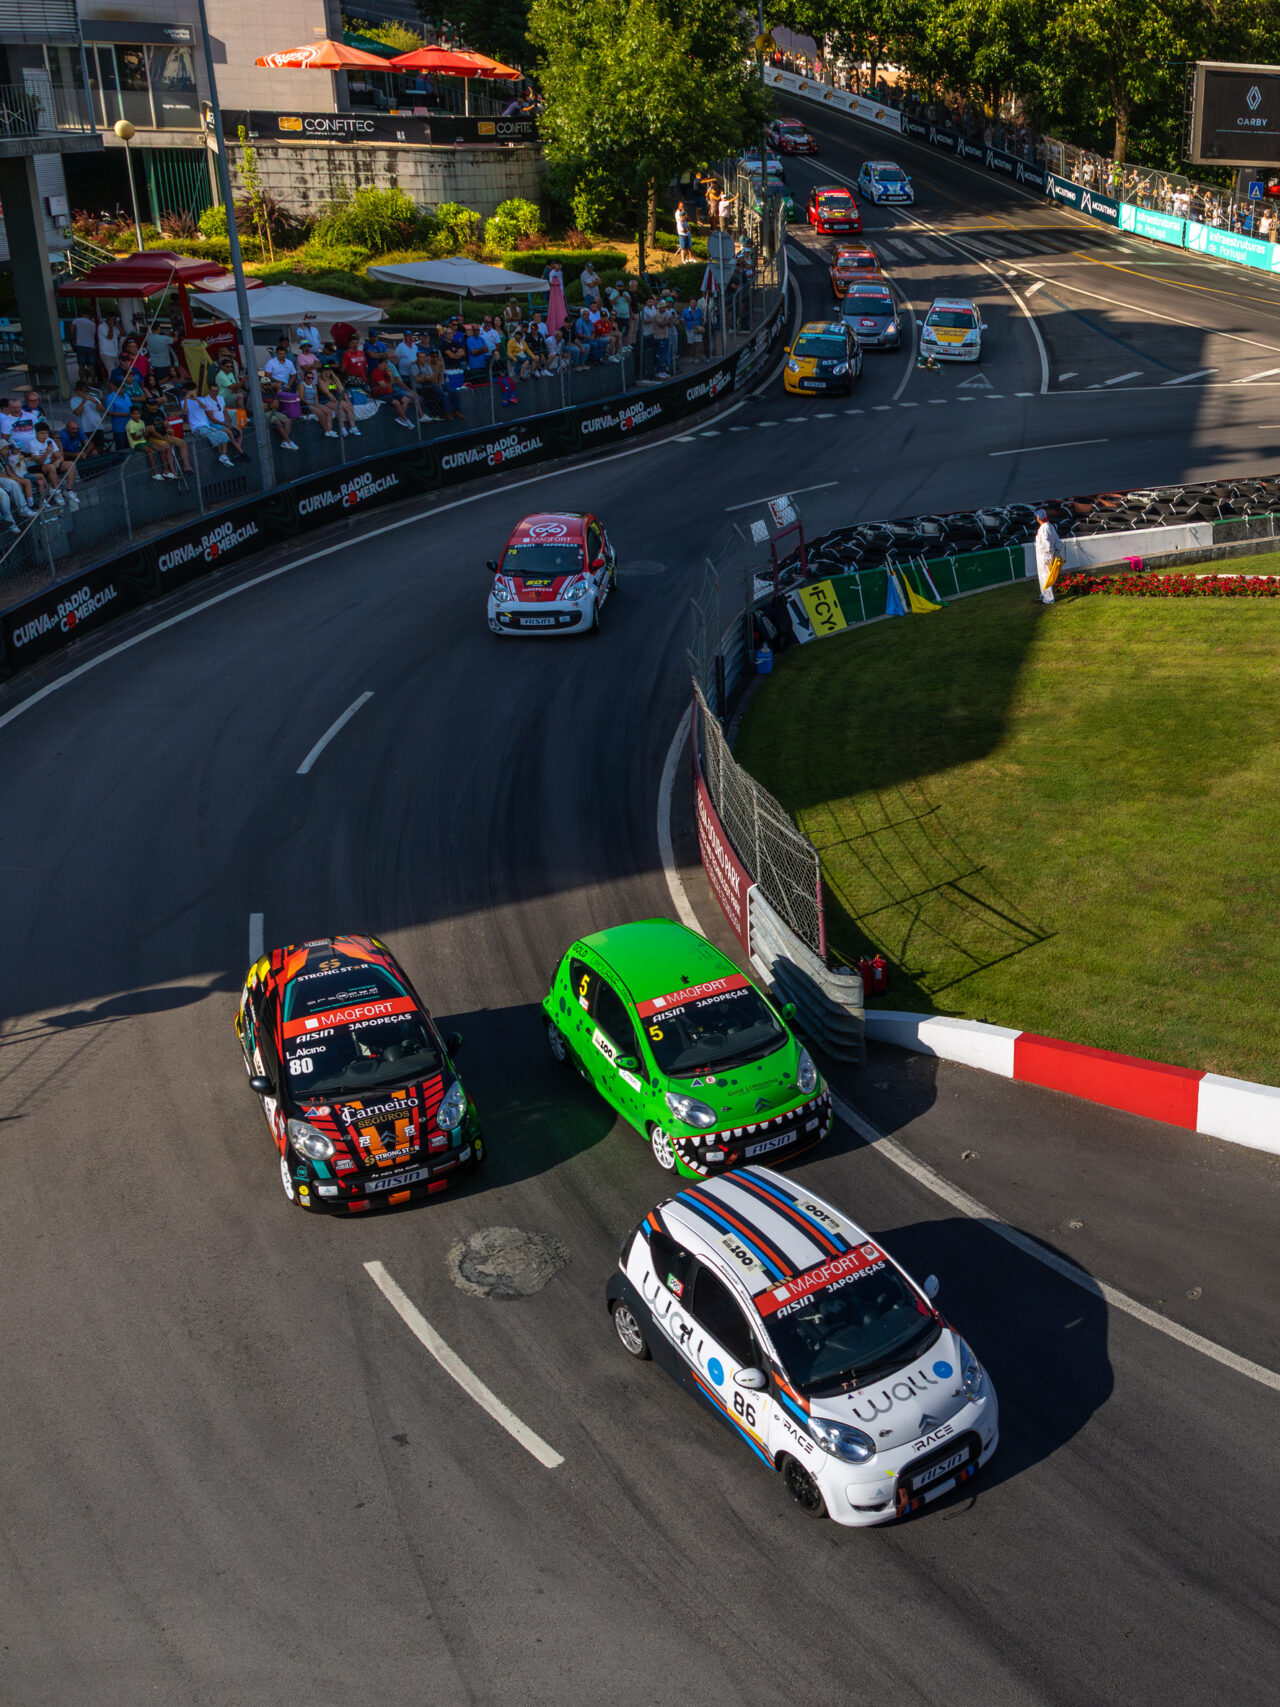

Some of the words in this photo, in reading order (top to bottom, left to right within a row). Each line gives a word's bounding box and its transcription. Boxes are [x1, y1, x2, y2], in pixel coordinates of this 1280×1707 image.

[304, 117, 374, 132] CONFITEC
[1237, 117, 1268, 126] CARBY
[1137, 211, 1181, 232] Infraestruturas
[1145, 224, 1166, 239] Portugal
[1208, 243, 1217, 252] de
[1219, 245, 1247, 261] Portugal
[1209, 231, 1266, 255] Infraestruturas
[581, 413, 613, 434] CURVA
[618, 401, 644, 421] RADIO
[442, 448, 479, 470] CURVA
[486, 434, 518, 455] RADIO
[299, 490, 335, 515] CURVA
[340, 472, 373, 495] RADIO
[158, 543, 196, 572] CURVA
[201, 521, 233, 549] RADIO
[13, 613, 52, 647] CURVA
[57, 586, 90, 618] RADIO
[810, 588, 837, 629] FCY
[572, 943, 588, 958] GOLD
[298, 968, 339, 982] STRONG
[340, 964, 369, 973] STR
[579, 974, 590, 996] 5
[666, 978, 727, 1003] MAQFORT
[321, 1002, 393, 1025] MAQFORT
[652, 1007, 686, 1023] AISIN
[696, 989, 749, 1008] JAPOPEÇAS
[296, 1028, 334, 1043] AISIN
[349, 1013, 412, 1030] JAPOPEÇAS
[649, 1025, 664, 1041] 5
[600, 1040, 613, 1059] 100
[289, 1057, 314, 1075] 80
[358, 1110, 409, 1128] SEGUROS
[375, 1149, 401, 1161] STRONG
[402, 1145, 420, 1153] STR
[752, 1134, 791, 1154] AISIN
[375, 1171, 420, 1189] AISIN
[805, 1203, 830, 1221] 100
[730, 1245, 753, 1266] 100
[789, 1254, 862, 1294] MAQFORT
[777, 1294, 815, 1319] AISIN
[826, 1260, 886, 1293] JAPOPEÇAS
[734, 1391, 756, 1427] 86
[784, 1419, 815, 1455] RACE
[914, 1424, 954, 1452] RACE
[921, 1453, 962, 1485] AISIN
